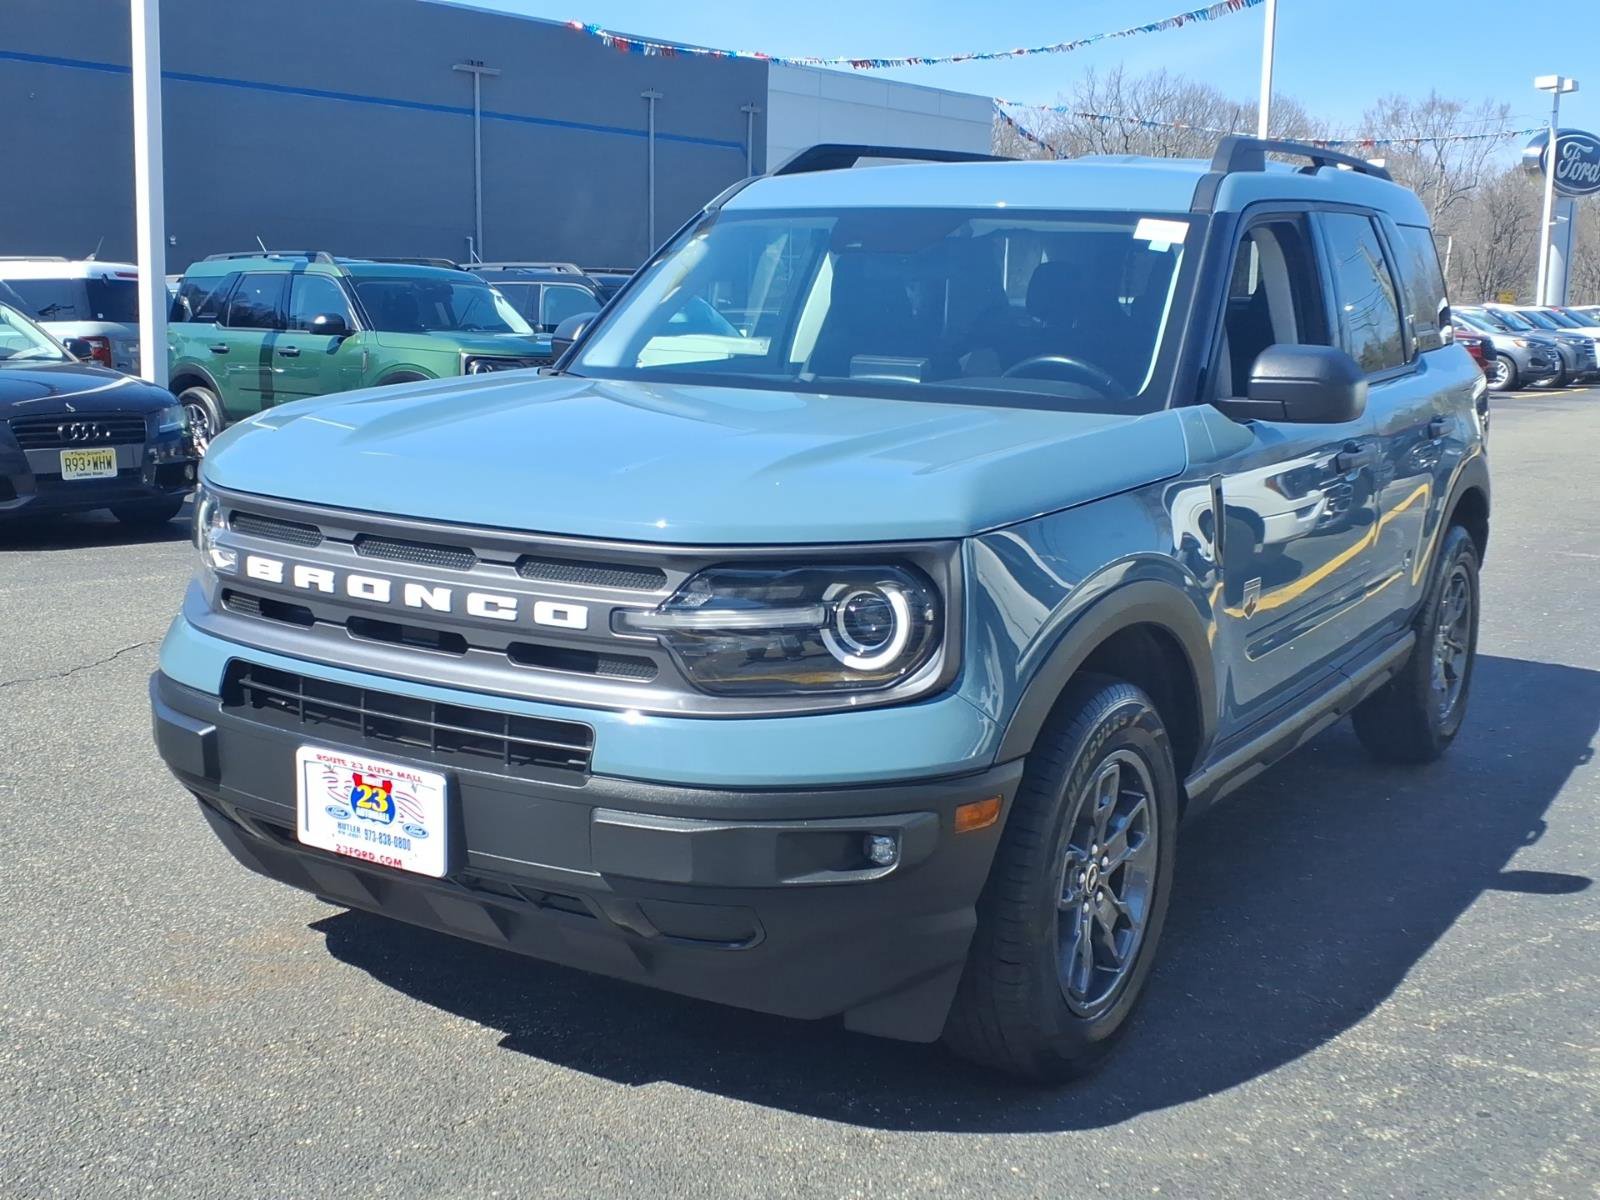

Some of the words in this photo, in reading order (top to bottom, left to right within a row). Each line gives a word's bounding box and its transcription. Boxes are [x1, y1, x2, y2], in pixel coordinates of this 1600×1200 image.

[246, 555, 589, 631] BRONCO
[316, 753, 346, 767] ROUTE
[351, 760, 364, 770] 23
[367, 765, 394, 776] AUTO
[397, 771, 423, 783] MALL
[356, 784, 389, 813] 23
[336, 844, 403, 868] 23FORD.COM
